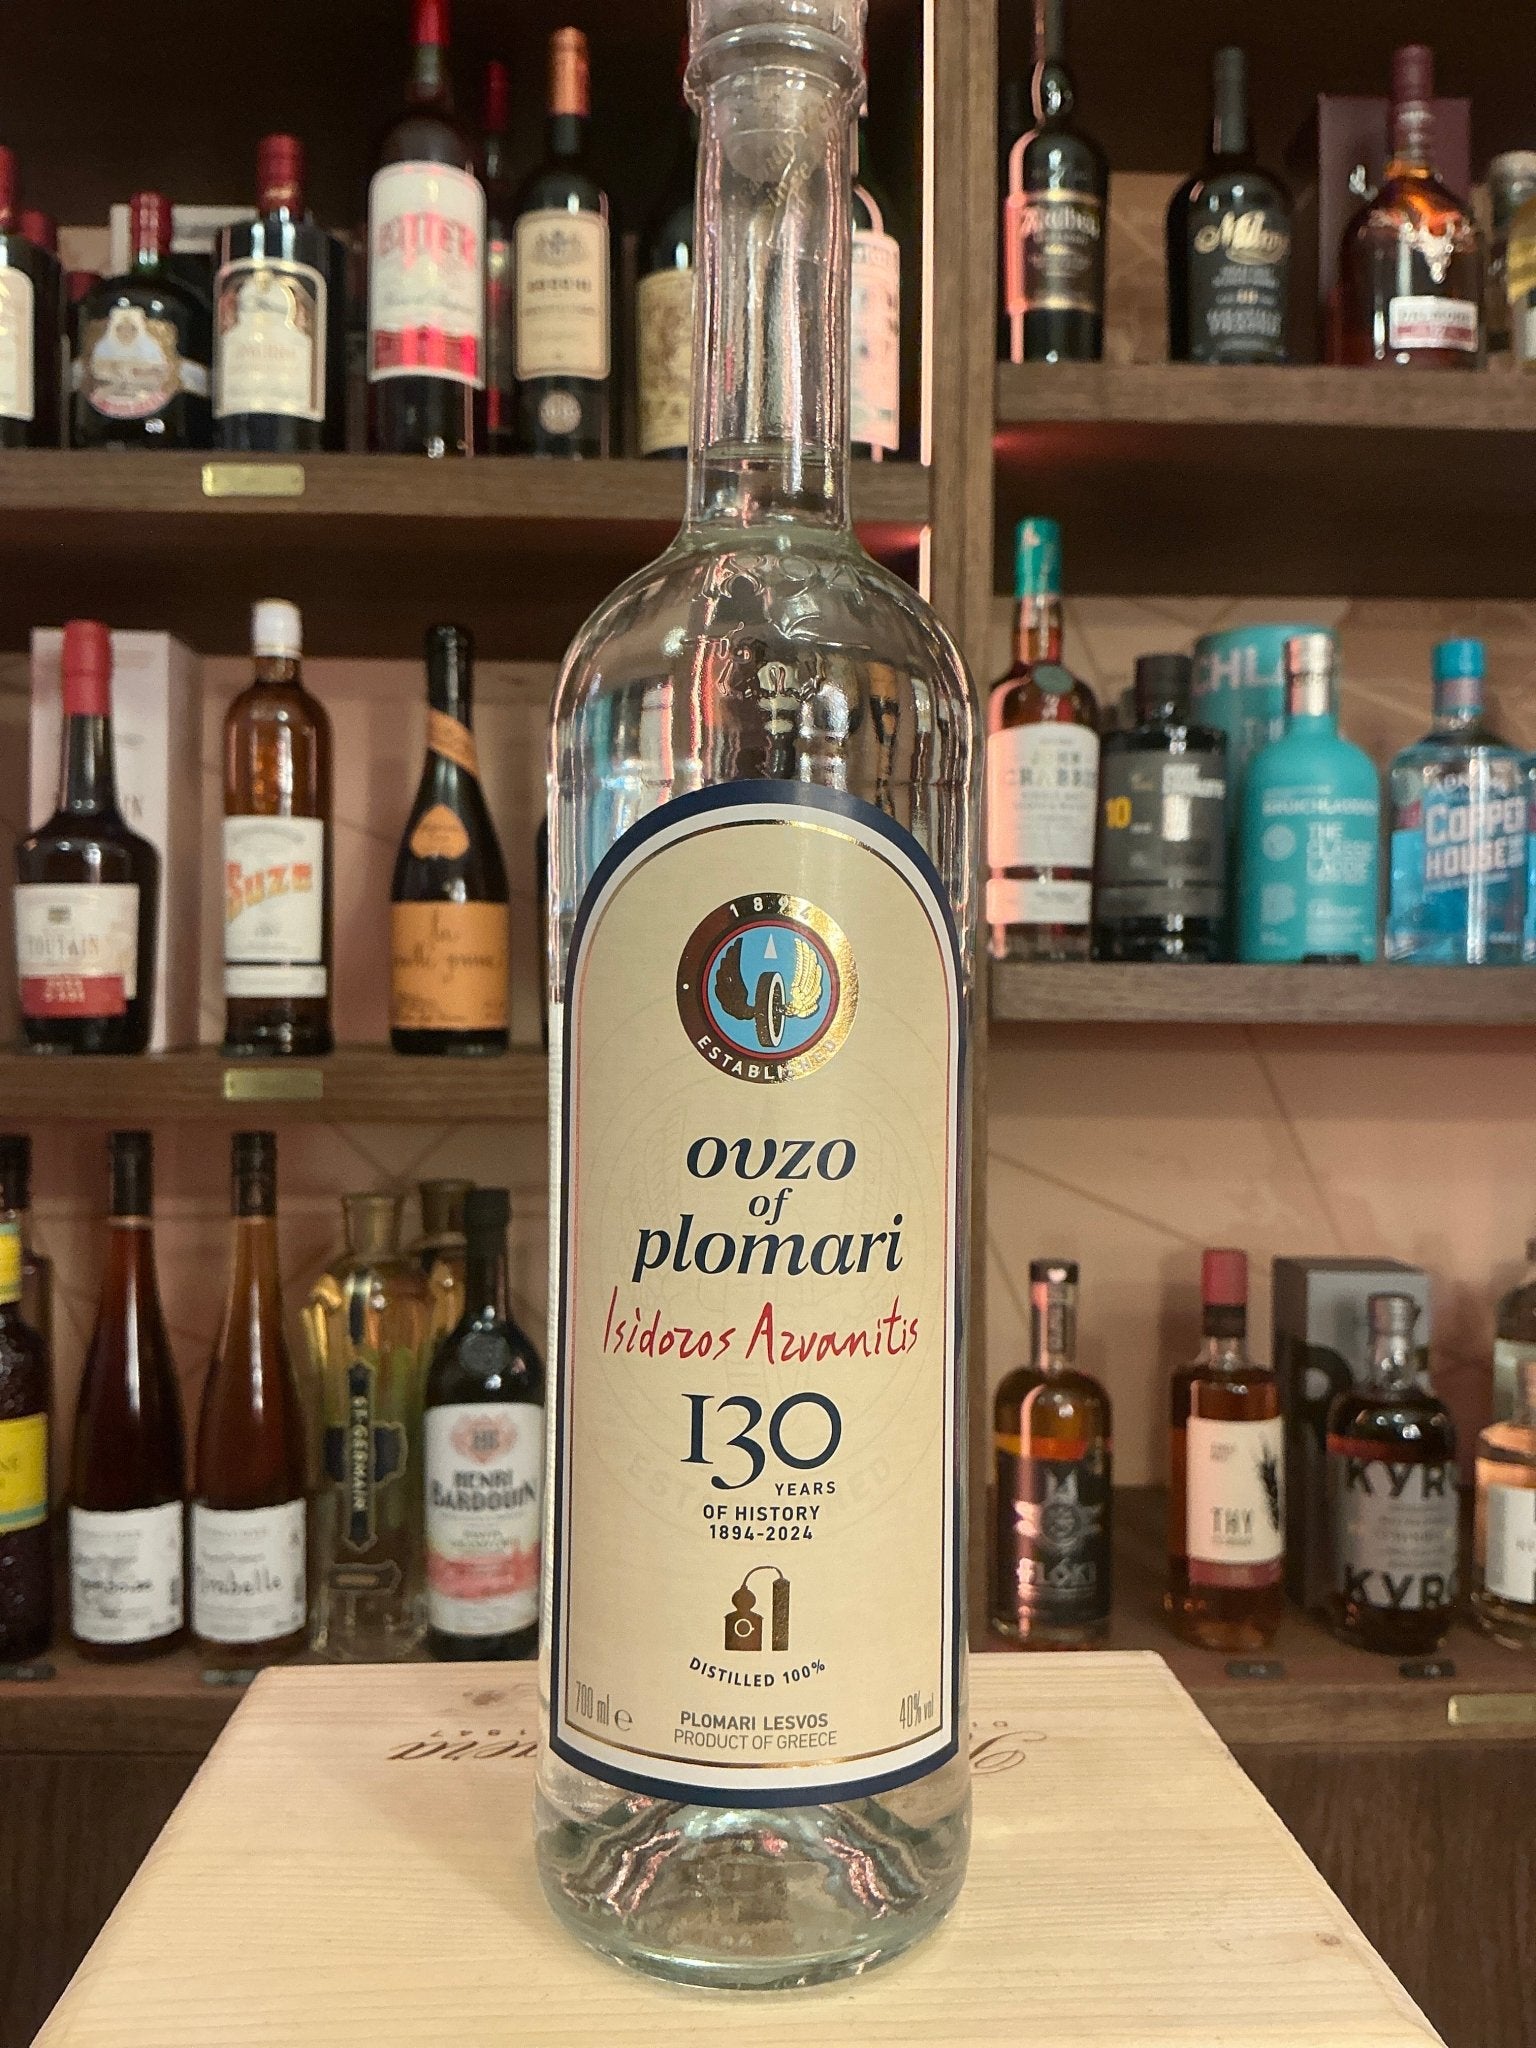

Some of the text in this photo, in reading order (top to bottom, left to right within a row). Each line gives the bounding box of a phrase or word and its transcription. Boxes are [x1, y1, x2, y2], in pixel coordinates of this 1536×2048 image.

[697, 1034, 837, 1080] ESTABLIHED
[687, 1136, 857, 1181] ouzo
[748, 1187, 793, 1226] of
[631, 1213, 904, 1283] plomari
[680, 1391, 842, 1490] 130
[774, 1481, 836, 1497] YEARS
[703, 1504, 820, 1522] OF HISTORY
[710, 1524, 813, 1542] 1894-2024
[689, 1657, 826, 1688] DISTILLED 100%
[575, 1680, 594, 1719] 700
[596, 1693, 610, 1726] ml
[681, 1710, 829, 1731] PLOMARI LESVOS
[899, 1690, 934, 1730] 40% vol
[674, 1728, 838, 1750] PRODUCT OF GREECE
